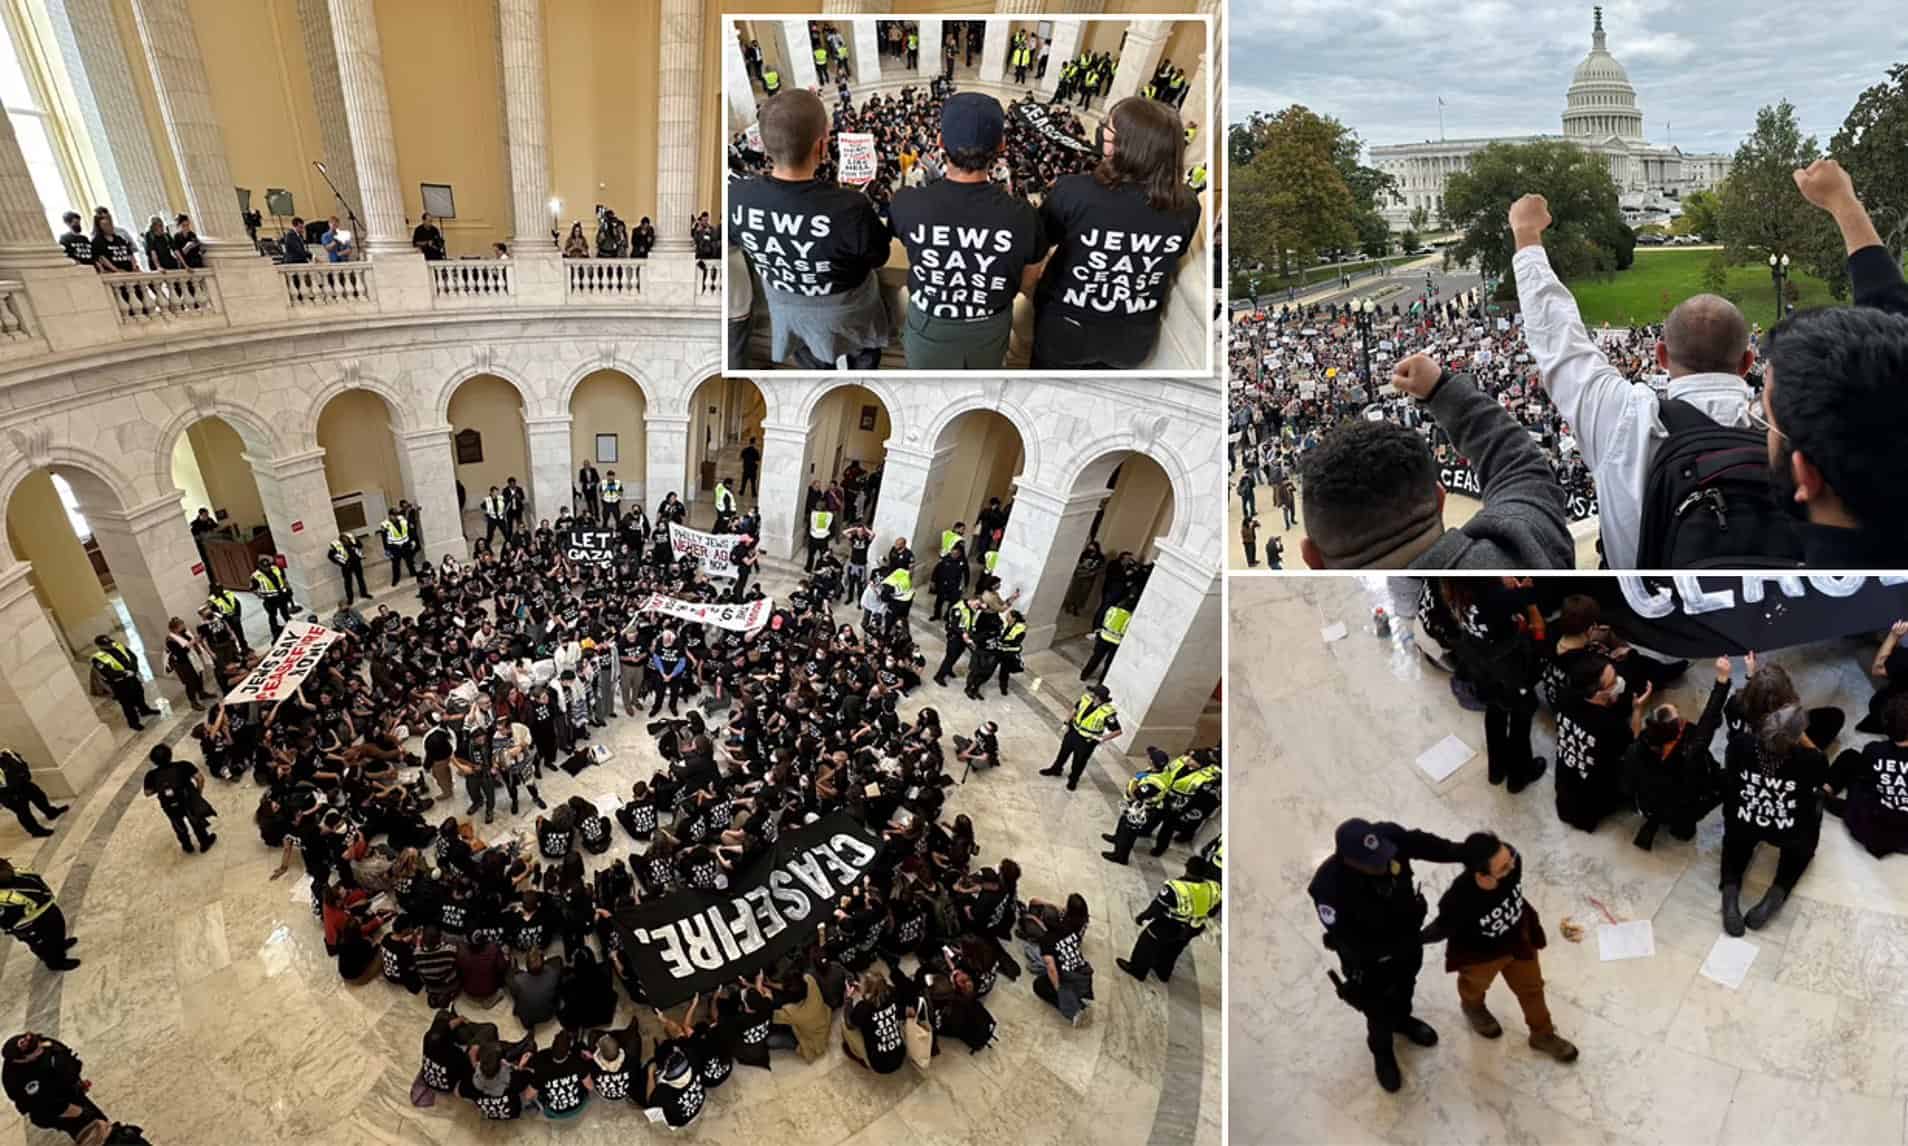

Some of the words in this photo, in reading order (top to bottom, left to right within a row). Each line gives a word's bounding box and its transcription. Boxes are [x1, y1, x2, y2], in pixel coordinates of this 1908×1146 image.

[732, 205, 832, 237] JEWS
[741, 232, 814, 259] SAY
[909, 224, 1013, 252] JEWS
[1080, 228, 1183, 253] JEWS
[922, 249, 997, 273] SAY
[1088, 251, 1162, 273] SAY
[912, 265, 1007, 290] CEASE
[1072, 266, 1164, 291] CEASE
[924, 285, 989, 304] FIRE
[1084, 283, 1150, 301] FIR
[571, 532, 610, 548] LET
[568, 548, 613, 560] GAZA
[240, 660, 280, 694] JEWS
[272, 630, 302, 658] SAY
[255, 626, 327, 701] CEASEFRE
[1740, 769, 1797, 791] JEWS
[1745, 784, 1787, 801] SAY
[1738, 806, 1795, 829] NOW
[634, 834, 876, 978] CEASEFIRE,
[1480, 897, 1510, 927] NOT
